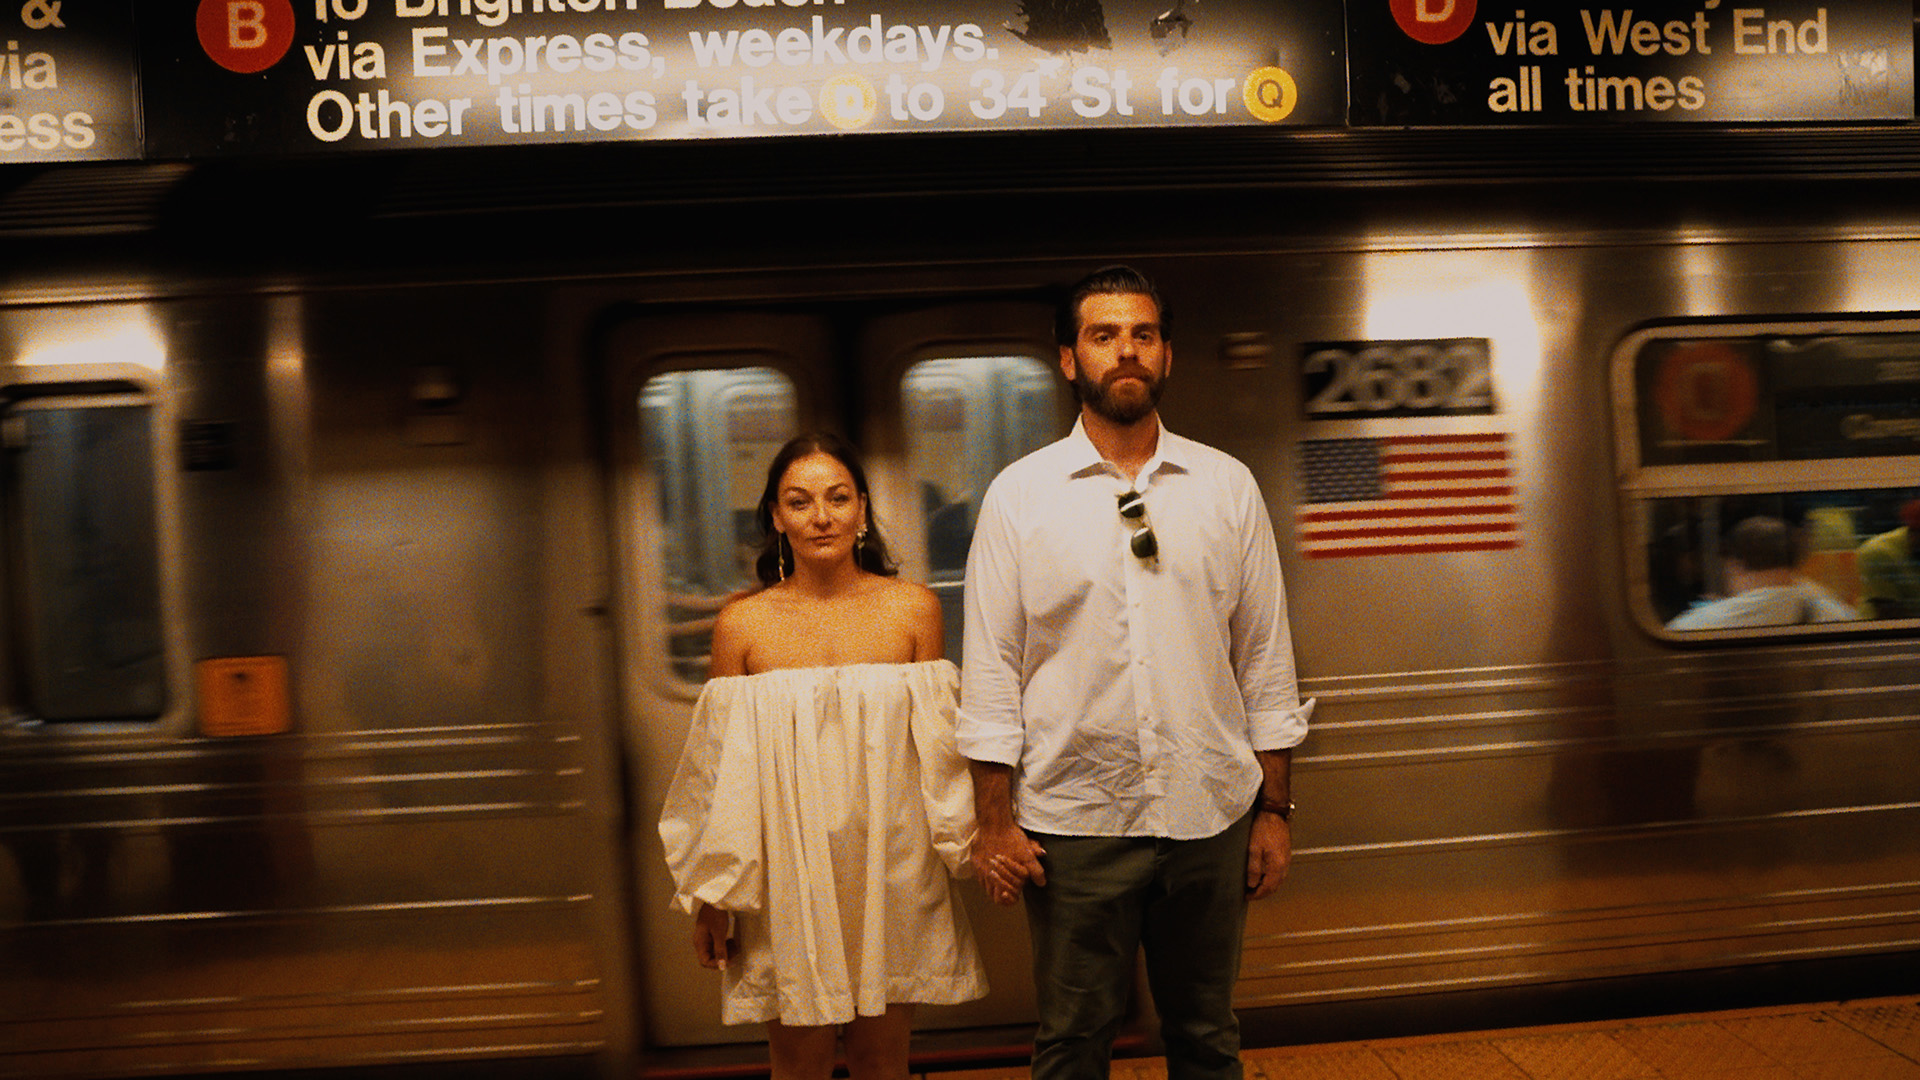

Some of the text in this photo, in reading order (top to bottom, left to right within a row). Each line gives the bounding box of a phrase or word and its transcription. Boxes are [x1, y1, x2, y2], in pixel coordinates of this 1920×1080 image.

[227, 1, 268, 49] B
[304, 14, 998, 85] via Express, weekdays.
[1485, 8, 1829, 56] via West End
[306, 89, 472, 142] Other
[496, 83, 657, 134] times
[682, 76, 813, 129] take
[885, 74, 945, 122] to
[969, 68, 1048, 120] 34
[1071, 66, 1133, 118] St
[1156, 67, 1236, 116] for
[1256, 78, 1284, 110] Q
[1488, 65, 1706, 113] all times
[1303, 345, 1492, 413] 2682
